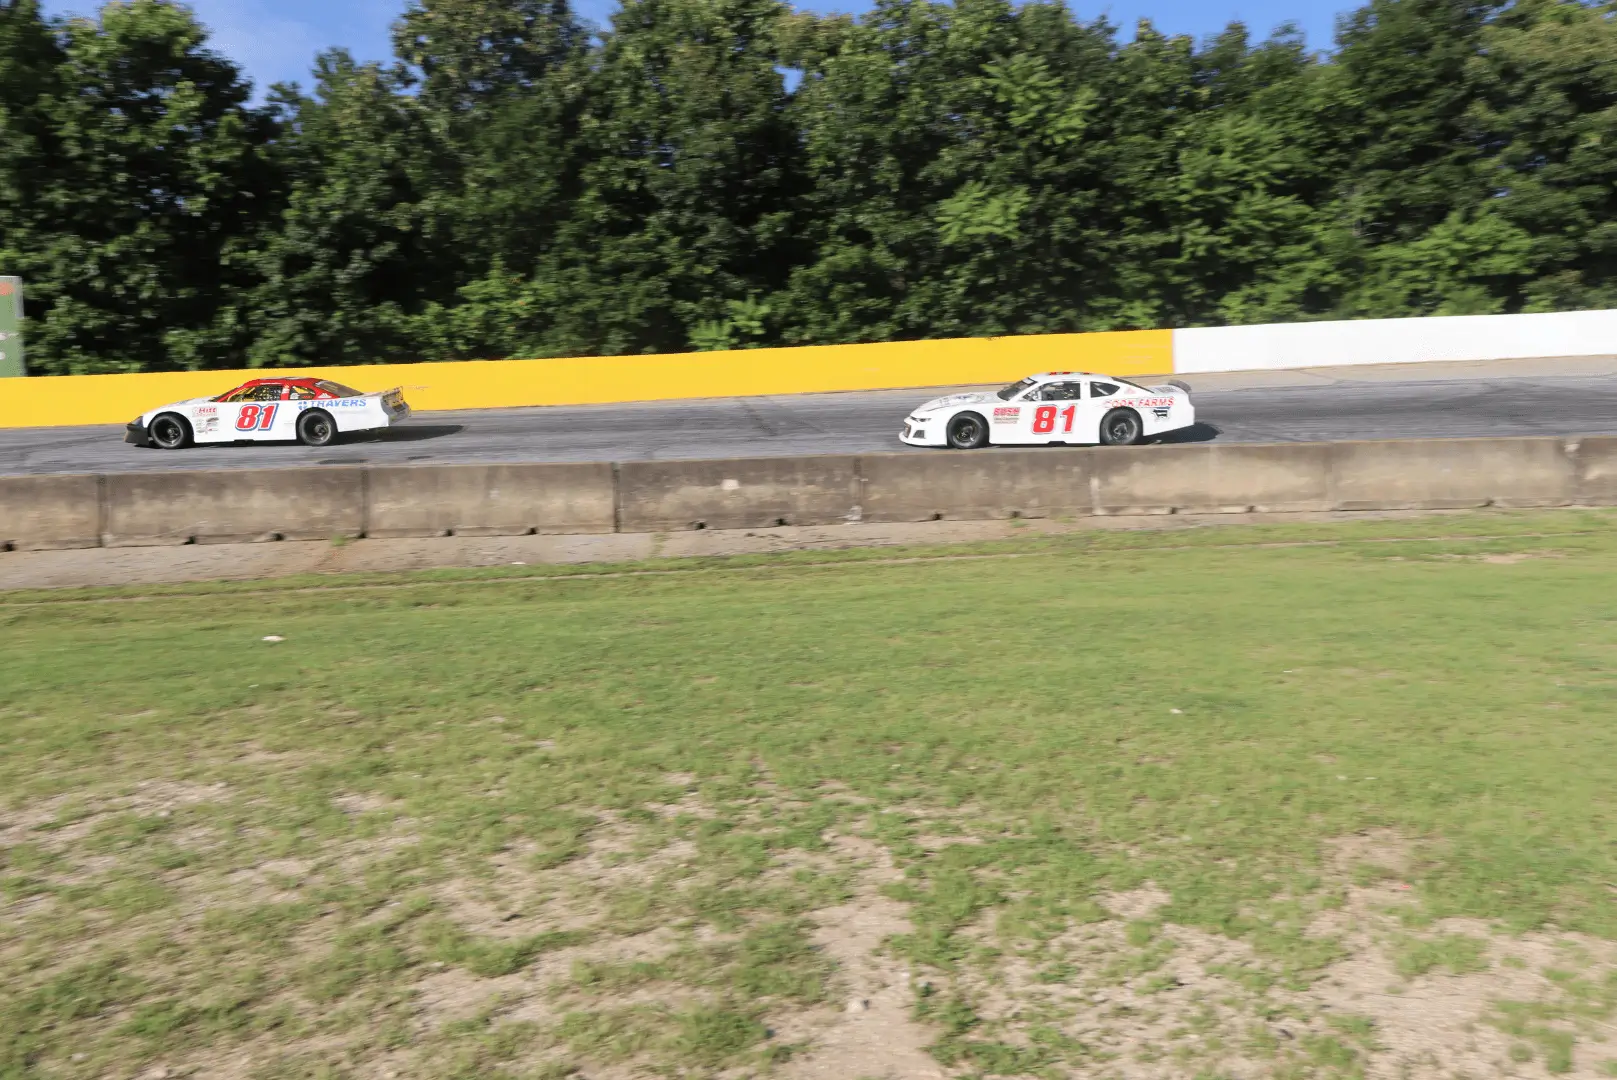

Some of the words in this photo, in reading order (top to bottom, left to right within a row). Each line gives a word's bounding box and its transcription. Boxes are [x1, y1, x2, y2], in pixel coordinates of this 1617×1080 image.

[1138, 396, 1175, 407] FARMS
[235, 403, 279, 431] 81
[1032, 403, 1077, 435] 81
